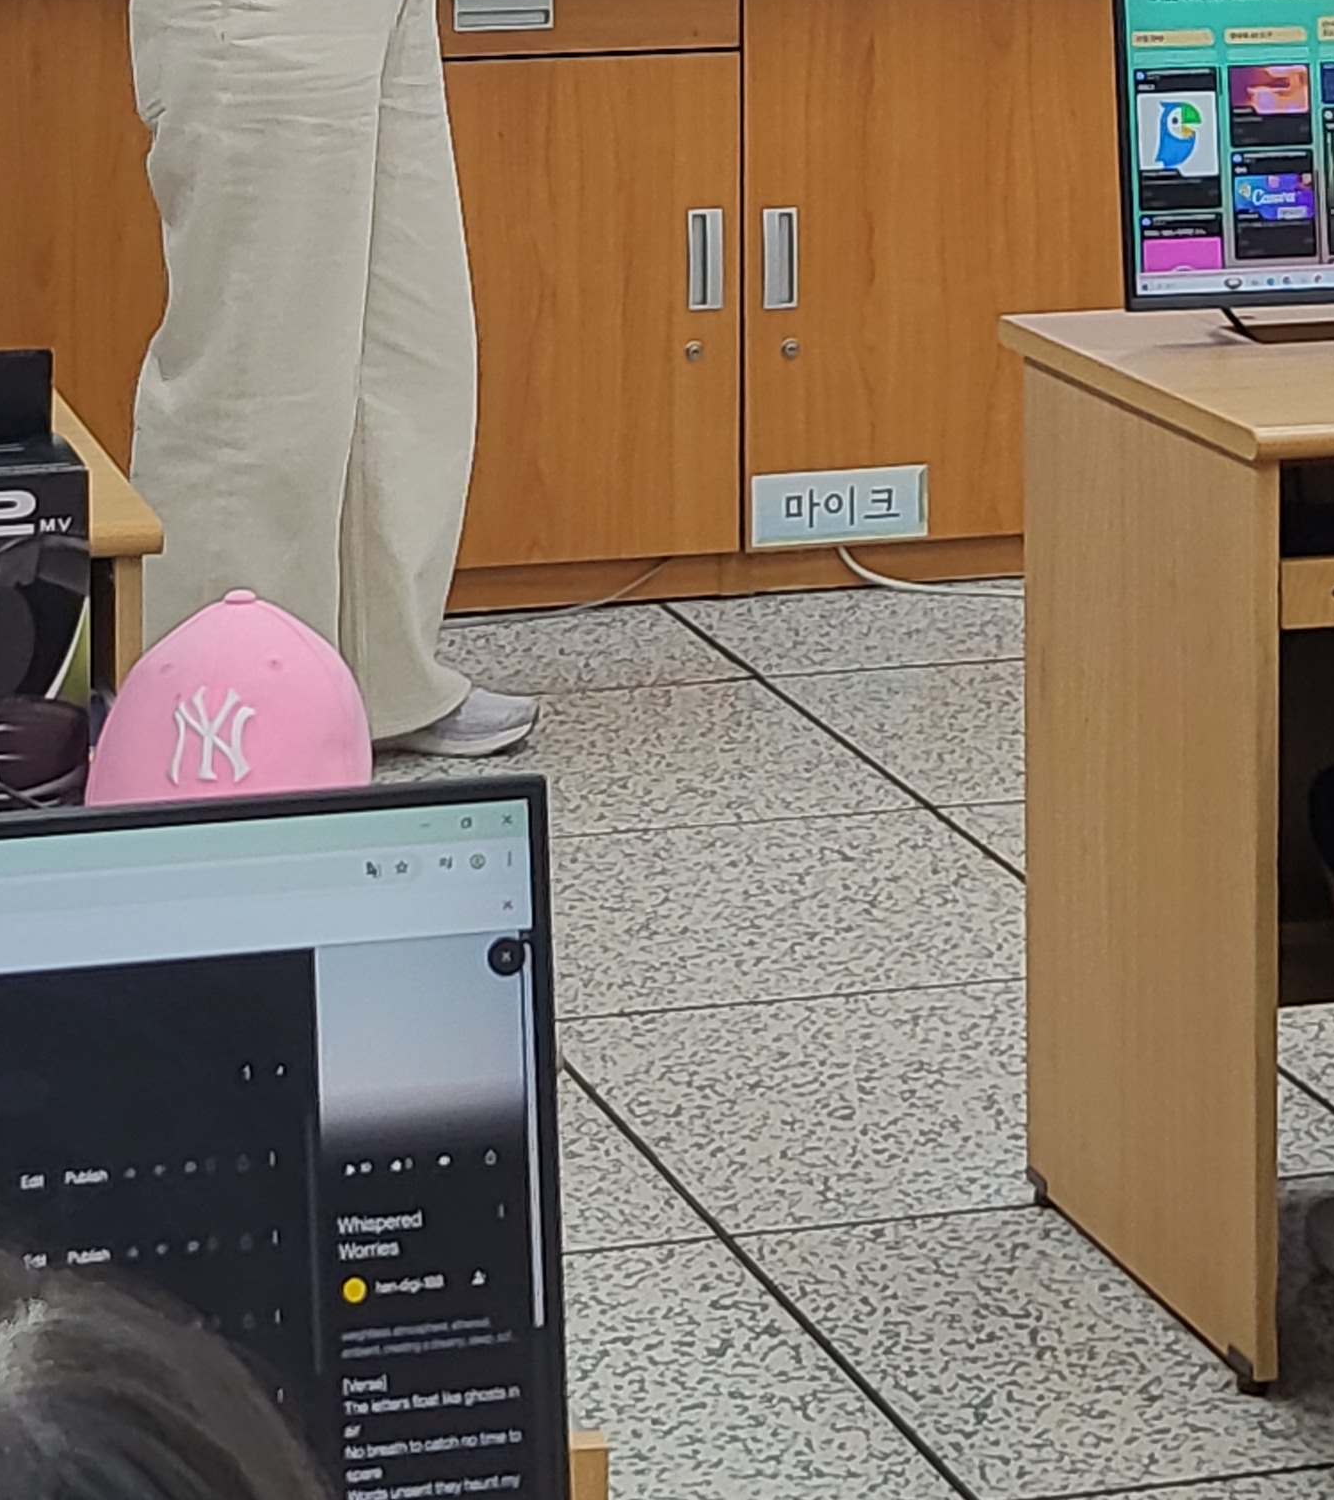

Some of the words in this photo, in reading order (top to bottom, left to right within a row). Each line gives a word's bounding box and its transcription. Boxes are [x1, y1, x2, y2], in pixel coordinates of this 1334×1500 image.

[784, 485, 901, 529] 마이크
[39, 516, 73, 532] MV
[167, 686, 255, 786] NY
[336, 1209, 423, 1235] Whispered
[338, 1241, 400, 1261] Worries
